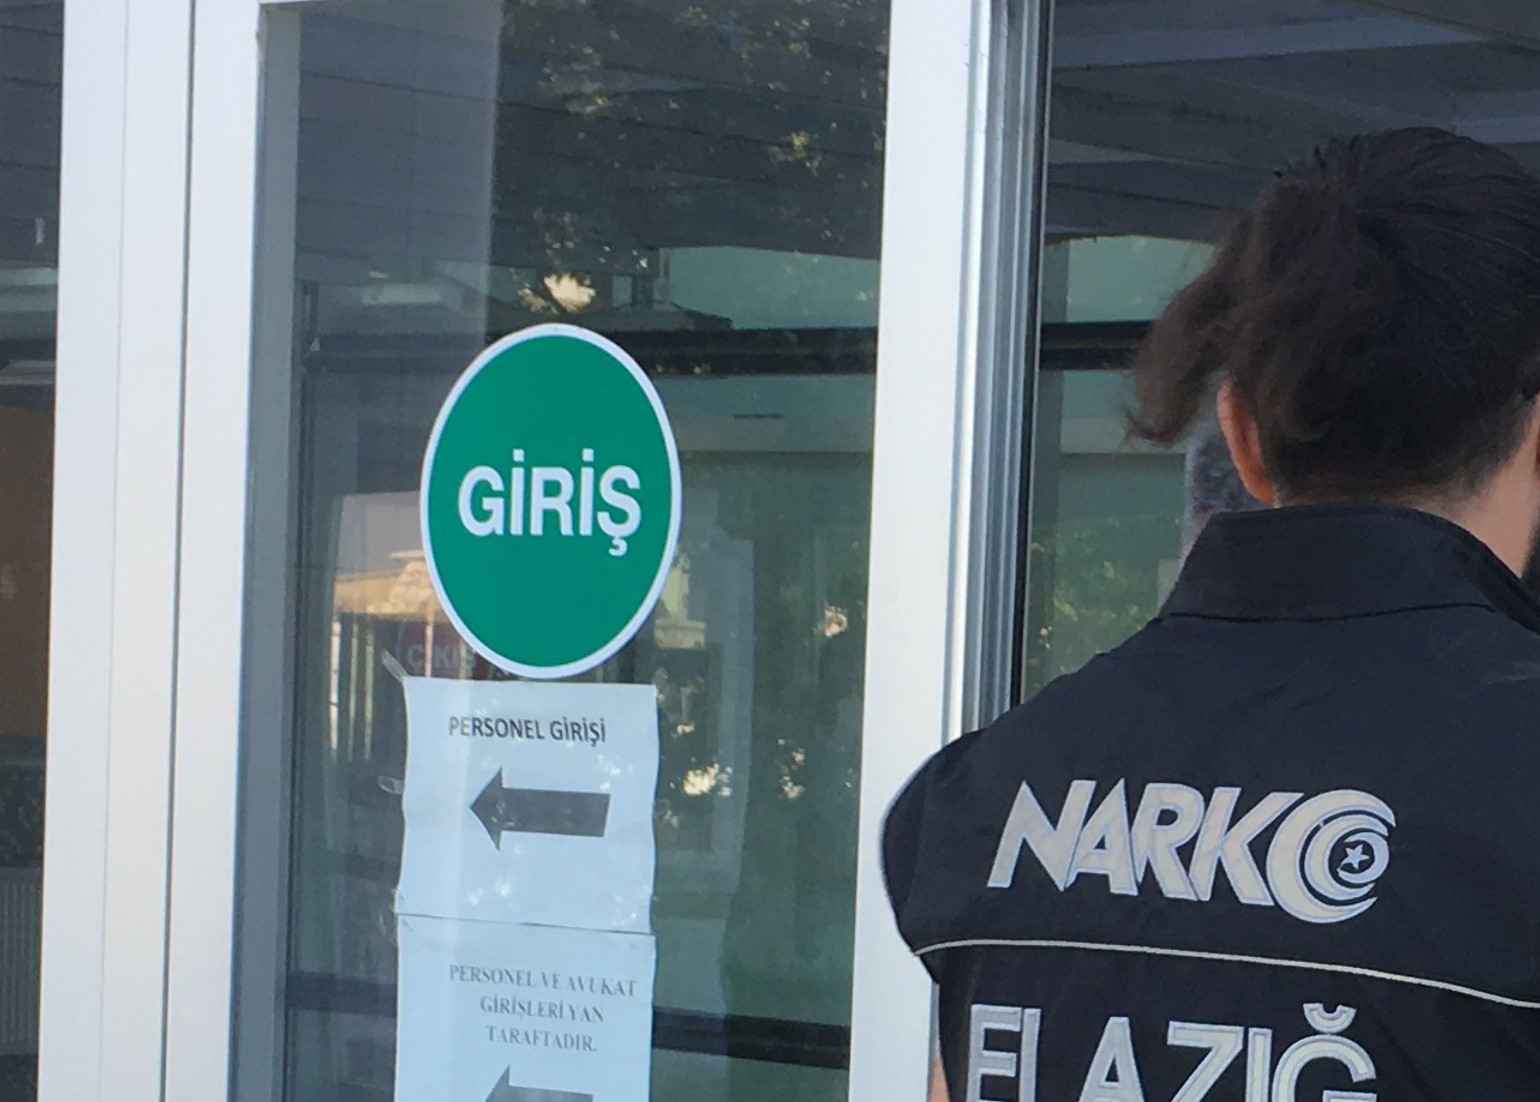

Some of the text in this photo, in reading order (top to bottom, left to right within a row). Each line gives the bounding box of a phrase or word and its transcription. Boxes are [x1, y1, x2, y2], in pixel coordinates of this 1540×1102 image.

[457, 448, 641, 557] GİRİŞ
[449, 716, 607, 747] PERSONEL GİRİŞİ
[449, 963, 638, 998] PERSONEL VE AVUKAT
[480, 993, 605, 1023] GİRİŞLERİ YAN
[485, 1025, 598, 1052] TARAFTADIR.
